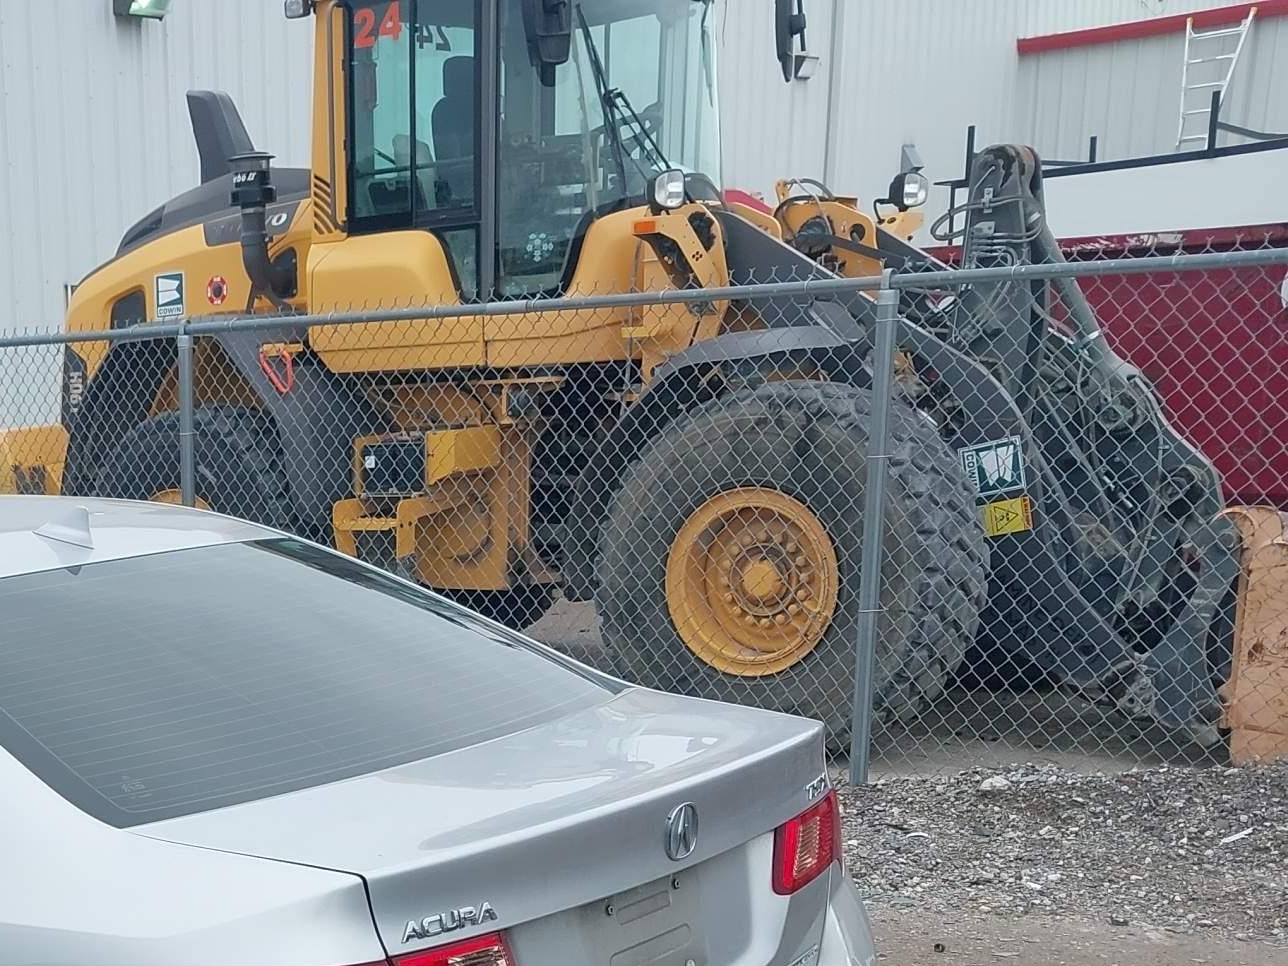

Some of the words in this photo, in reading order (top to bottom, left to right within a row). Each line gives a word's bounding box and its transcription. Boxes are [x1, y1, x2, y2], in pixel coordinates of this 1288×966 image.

[353, 0, 402, 48] 24
[158, 307, 182, 316] COWIN
[401, 901, 498, 945] ACURA
